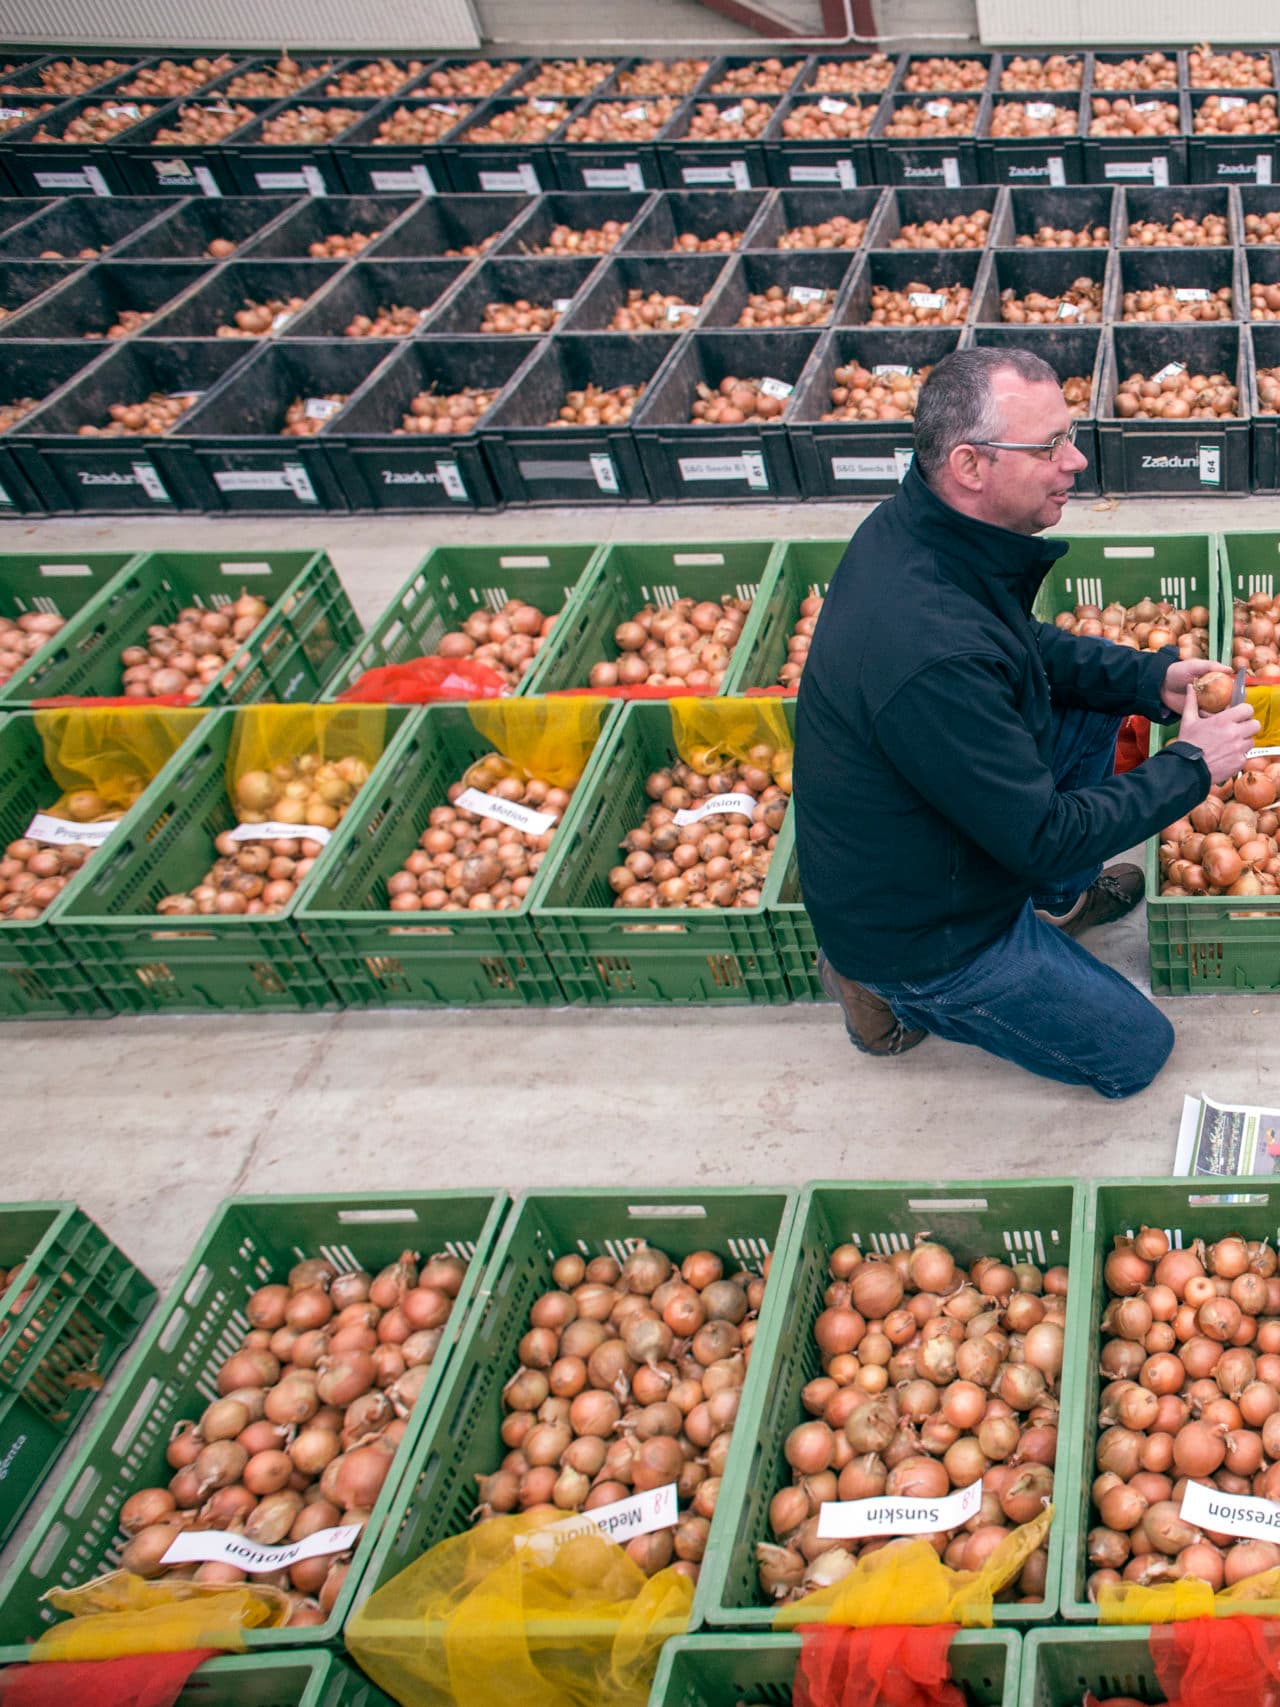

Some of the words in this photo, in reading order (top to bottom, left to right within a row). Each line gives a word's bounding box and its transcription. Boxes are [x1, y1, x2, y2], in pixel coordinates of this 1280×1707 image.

[1206, 461, 1215, 473] 64
[490, 803, 529, 824] Motion
[706, 799, 741, 811] Vision
[866, 1508, 939, 1525] Sunskin
[554, 1506, 643, 1547] Medaon
[224, 1543, 300, 1563] Motion
